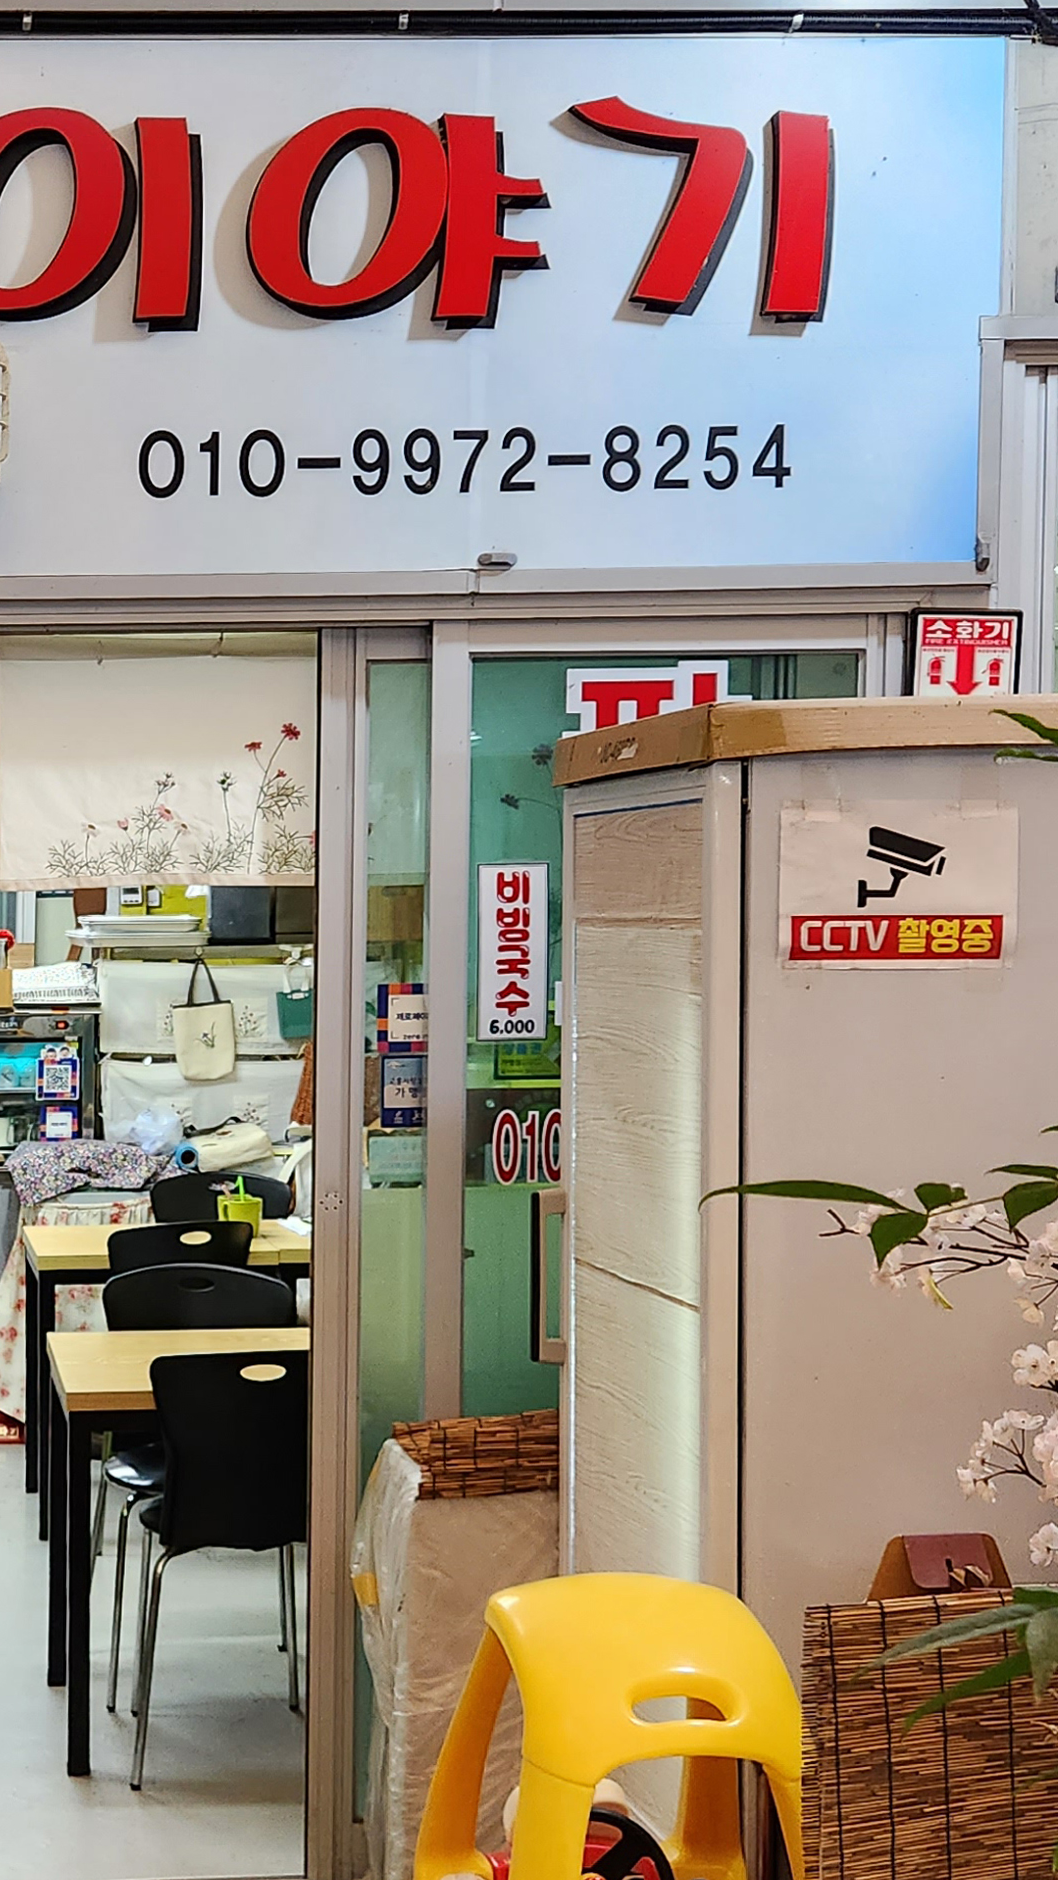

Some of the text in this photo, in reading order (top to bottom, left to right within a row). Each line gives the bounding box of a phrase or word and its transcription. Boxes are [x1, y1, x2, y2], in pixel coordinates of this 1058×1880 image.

[140, 424, 792, 497] 010-9972-8254
[925, 619, 1010, 640] 소화기
[495, 870, 531, 1017] 비빔국수
[800, 918, 993, 953] CCTV 촬영중
